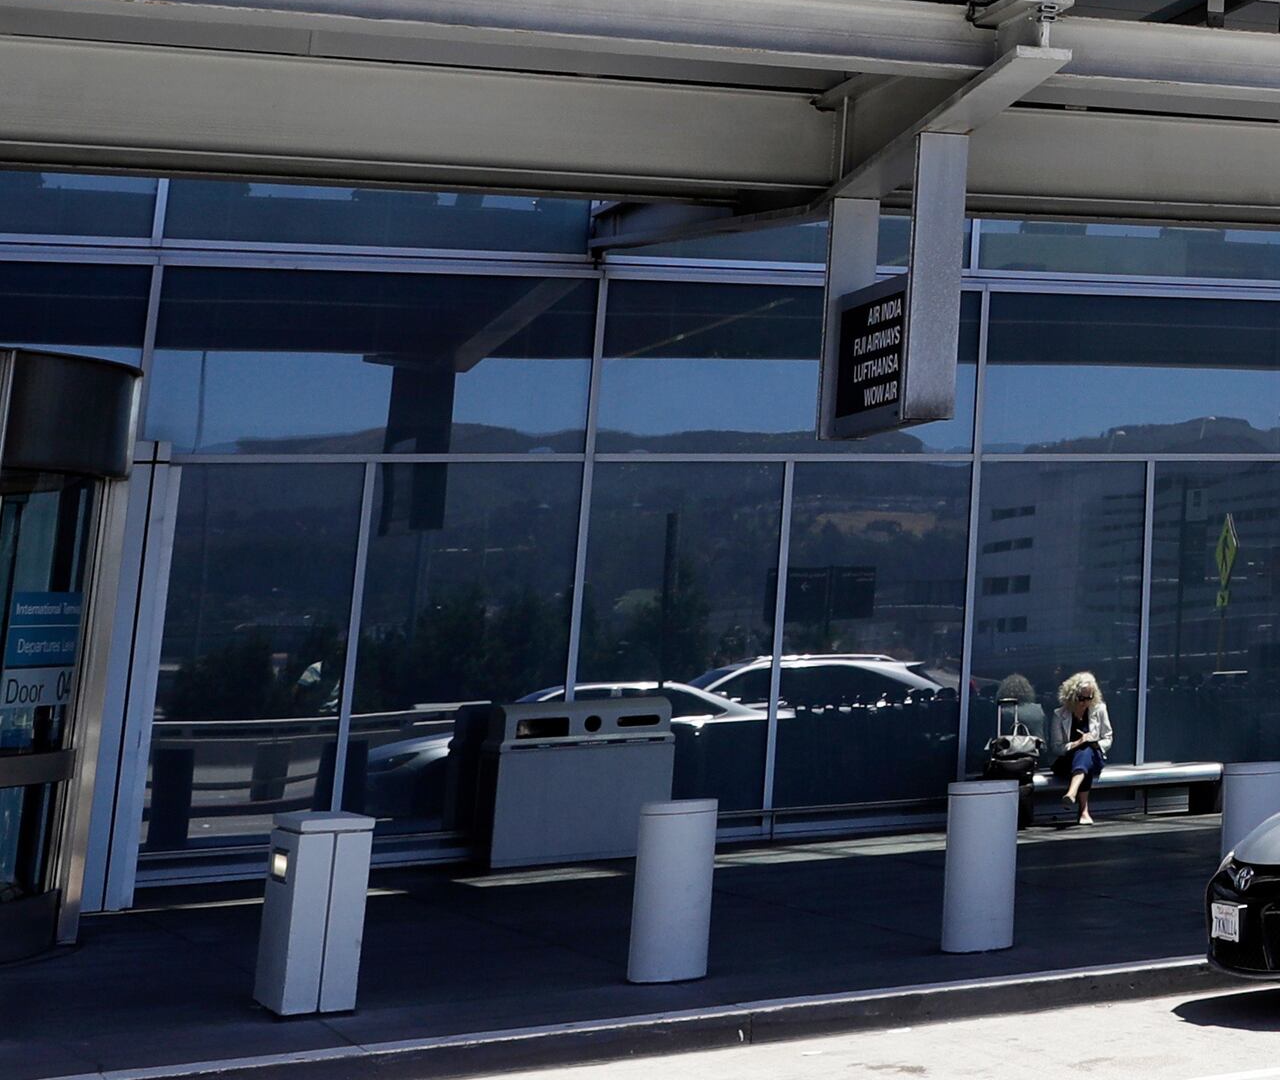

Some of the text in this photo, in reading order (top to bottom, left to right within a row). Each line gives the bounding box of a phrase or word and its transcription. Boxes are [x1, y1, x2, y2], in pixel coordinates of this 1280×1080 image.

[867, 298, 902, 326] AIR INDIA
[853, 325, 901, 357] FIJI AIRWAYS
[853, 353, 899, 384] LUFTHANSA
[863, 380, 898, 407] WOW AIR
[15, 602, 62, 616] International
[17, 638, 60, 656] Departures
[4, 678, 45, 704] Door
